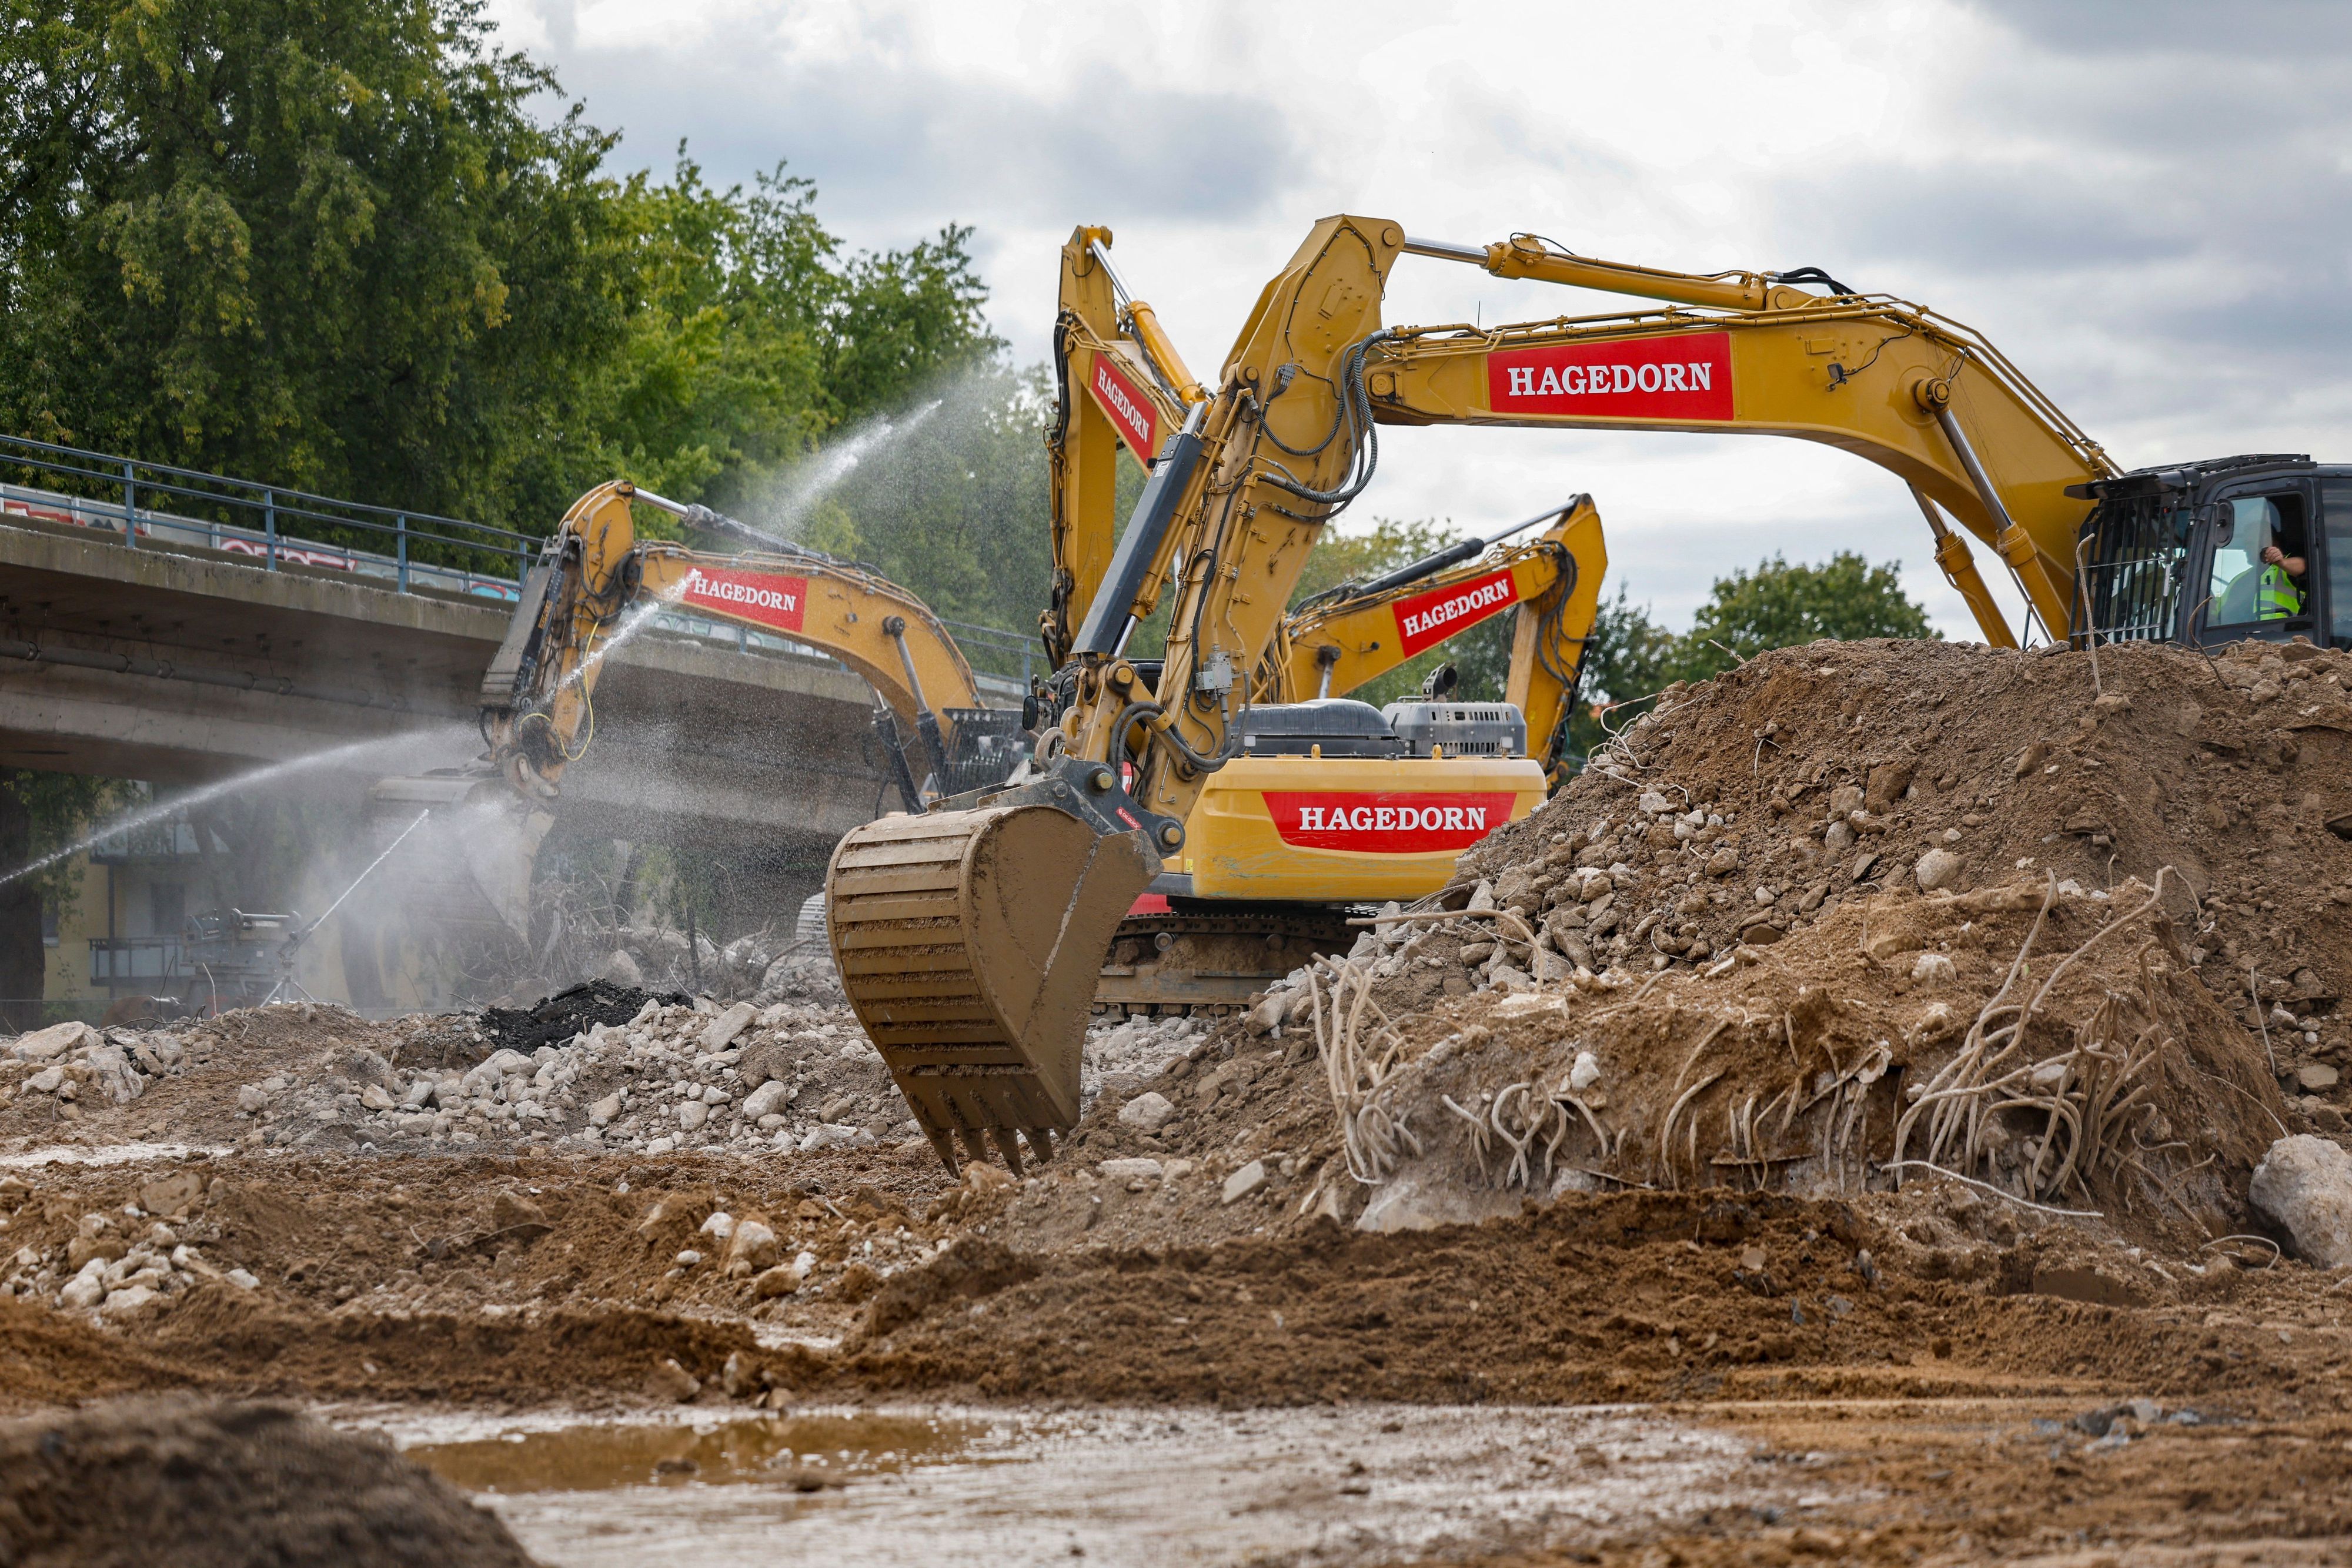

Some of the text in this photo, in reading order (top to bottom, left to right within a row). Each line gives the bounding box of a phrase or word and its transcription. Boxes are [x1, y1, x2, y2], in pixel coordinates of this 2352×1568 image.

[1508, 362, 1712, 397] HAGEDORN
[1098, 366, 1150, 443] HAGEDORN
[693, 577, 797, 612] HAGEDORN
[1403, 579, 1509, 637] HAGEDORN
[1299, 807, 1486, 832] HAGEDORN
